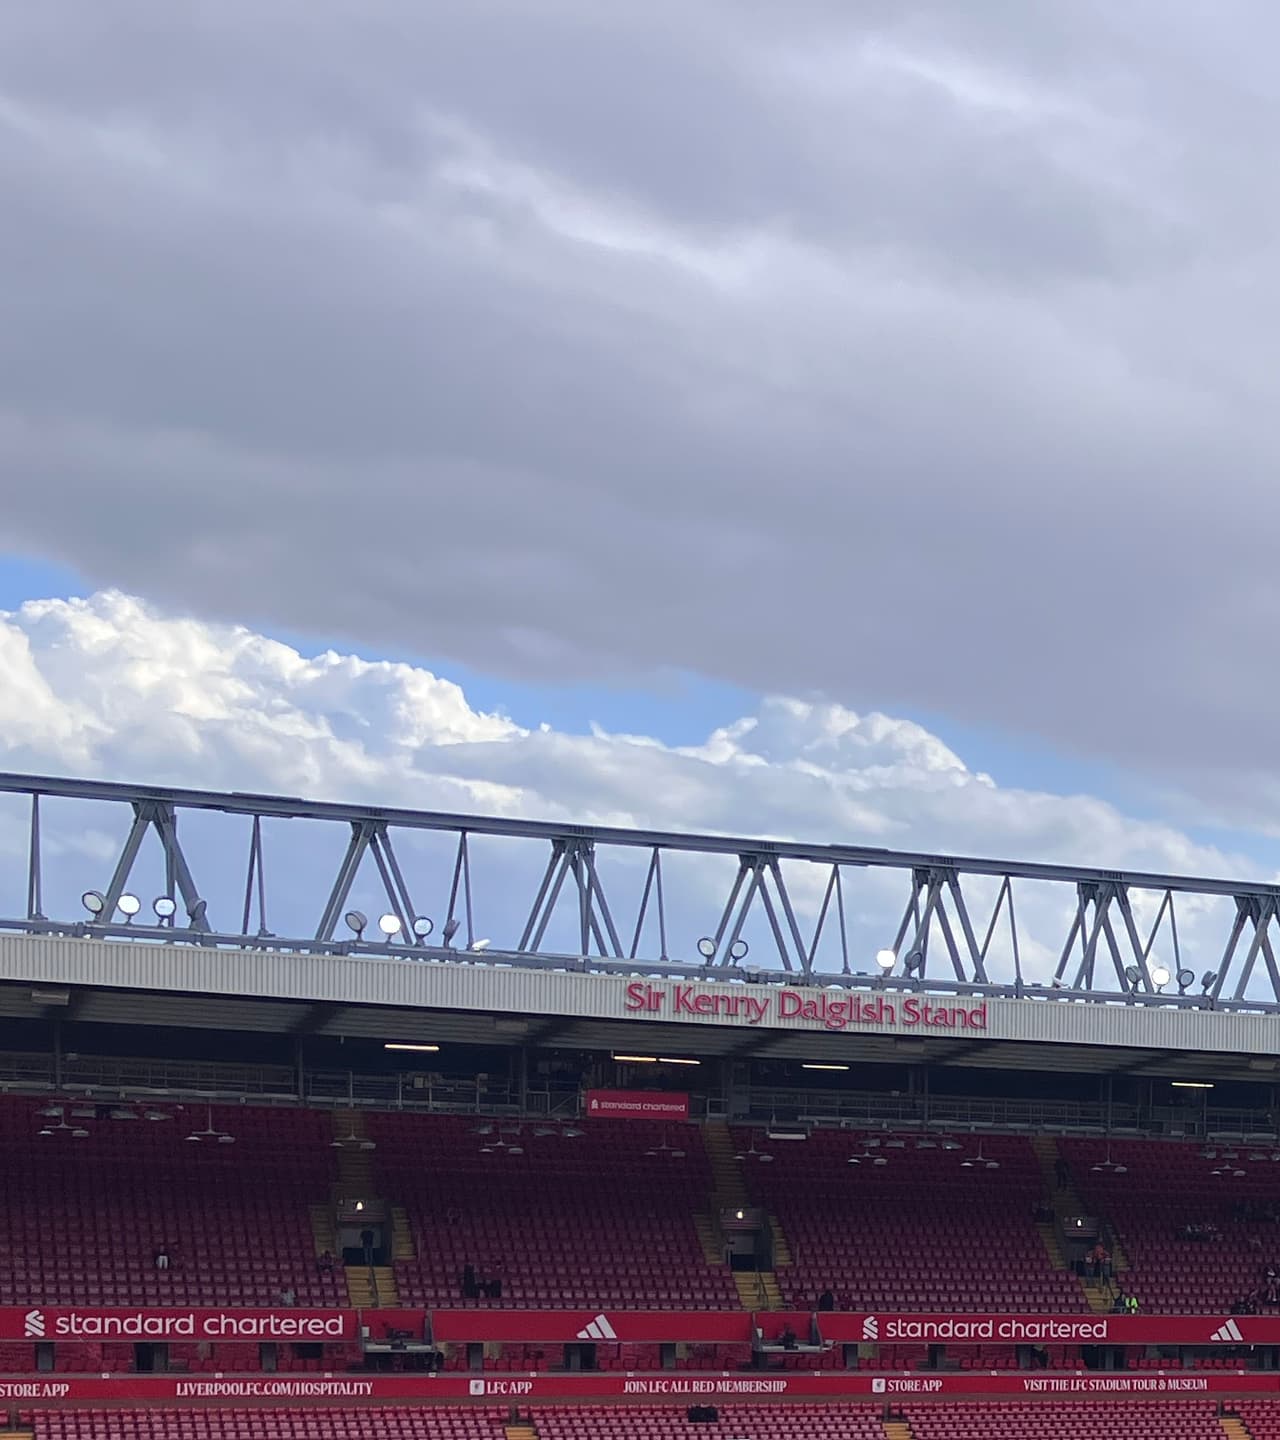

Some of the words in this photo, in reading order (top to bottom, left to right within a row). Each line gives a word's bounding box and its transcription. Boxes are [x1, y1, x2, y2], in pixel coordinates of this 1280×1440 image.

[626, 982, 666, 1011] Sir
[673, 985, 770, 1024] Kenny
[777, 991, 896, 1030] Dalglish
[902, 998, 987, 1030] Stand
[601, 1101, 642, 1111] standard
[643, 1102, 685, 1112] chartered
[55, 1313, 194, 1335] standard
[203, 1314, 344, 1335] chartered
[886, 1319, 993, 1338] standard
[998, 1320, 1107, 1338] chartered
[0, 1383, 41, 1398] STORE
[42, 1383, 70, 1398] APP
[176, 1381, 373, 1397] LIVERPOOLFC.COM/HOSPITALITY
[486, 1381, 508, 1395] LFC
[508, 1381, 533, 1395] APP
[623, 1380, 648, 1393] JOIN
[649, 1380, 669, 1393] LFC
[670, 1380, 691, 1393] ALL
[692, 1380, 714, 1393] RED
[715, 1380, 787, 1393] MEMBERSHIP
[887, 1379, 921, 1392] STORE
[921, 1379, 943, 1392] APP
[1023, 1379, 1049, 1391] VISIT
[1049, 1379, 1069, 1391] THE
[1070, 1379, 1088, 1391] LFC
[1089, 1379, 1131, 1391] STADIUM
[1132, 1379, 1157, 1391] TOUR
[1157, 1379, 1166, 1391] &
[1167, 1379, 1208, 1391] MUSEUM
